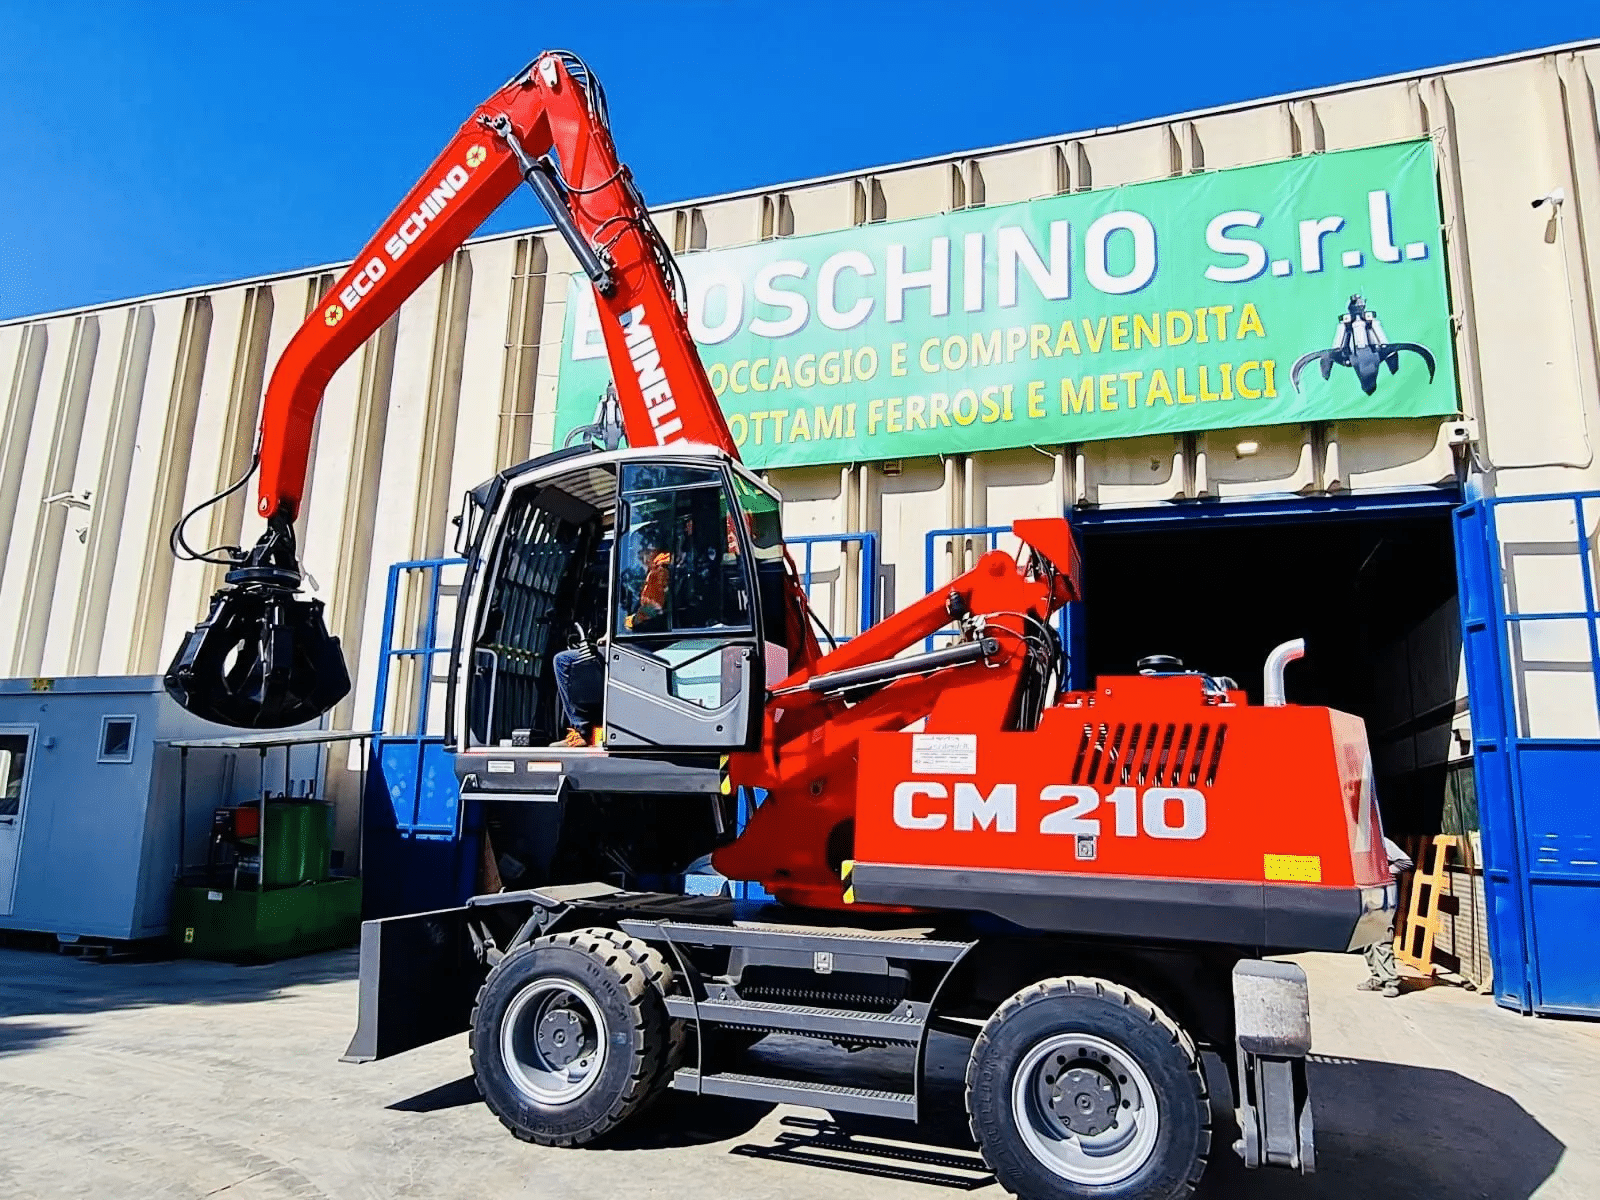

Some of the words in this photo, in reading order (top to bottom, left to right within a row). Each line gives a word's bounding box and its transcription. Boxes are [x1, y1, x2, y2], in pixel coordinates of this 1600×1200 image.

[339, 256, 387, 311] ECO
[384, 164, 469, 261] SCHINO
[570, 210, 1159, 361] EOSCHINO
[891, 340, 908, 377] E
[919, 302, 1267, 374] COMPRAVENDITA
[732, 403, 856, 450] OTTAMI
[868, 385, 1014, 436] FERROSI
[1028, 380, 1046, 419] E
[1060, 359, 1279, 416] METALLICI
[892, 780, 1018, 834] CM
[1038, 783, 1208, 841] 210
